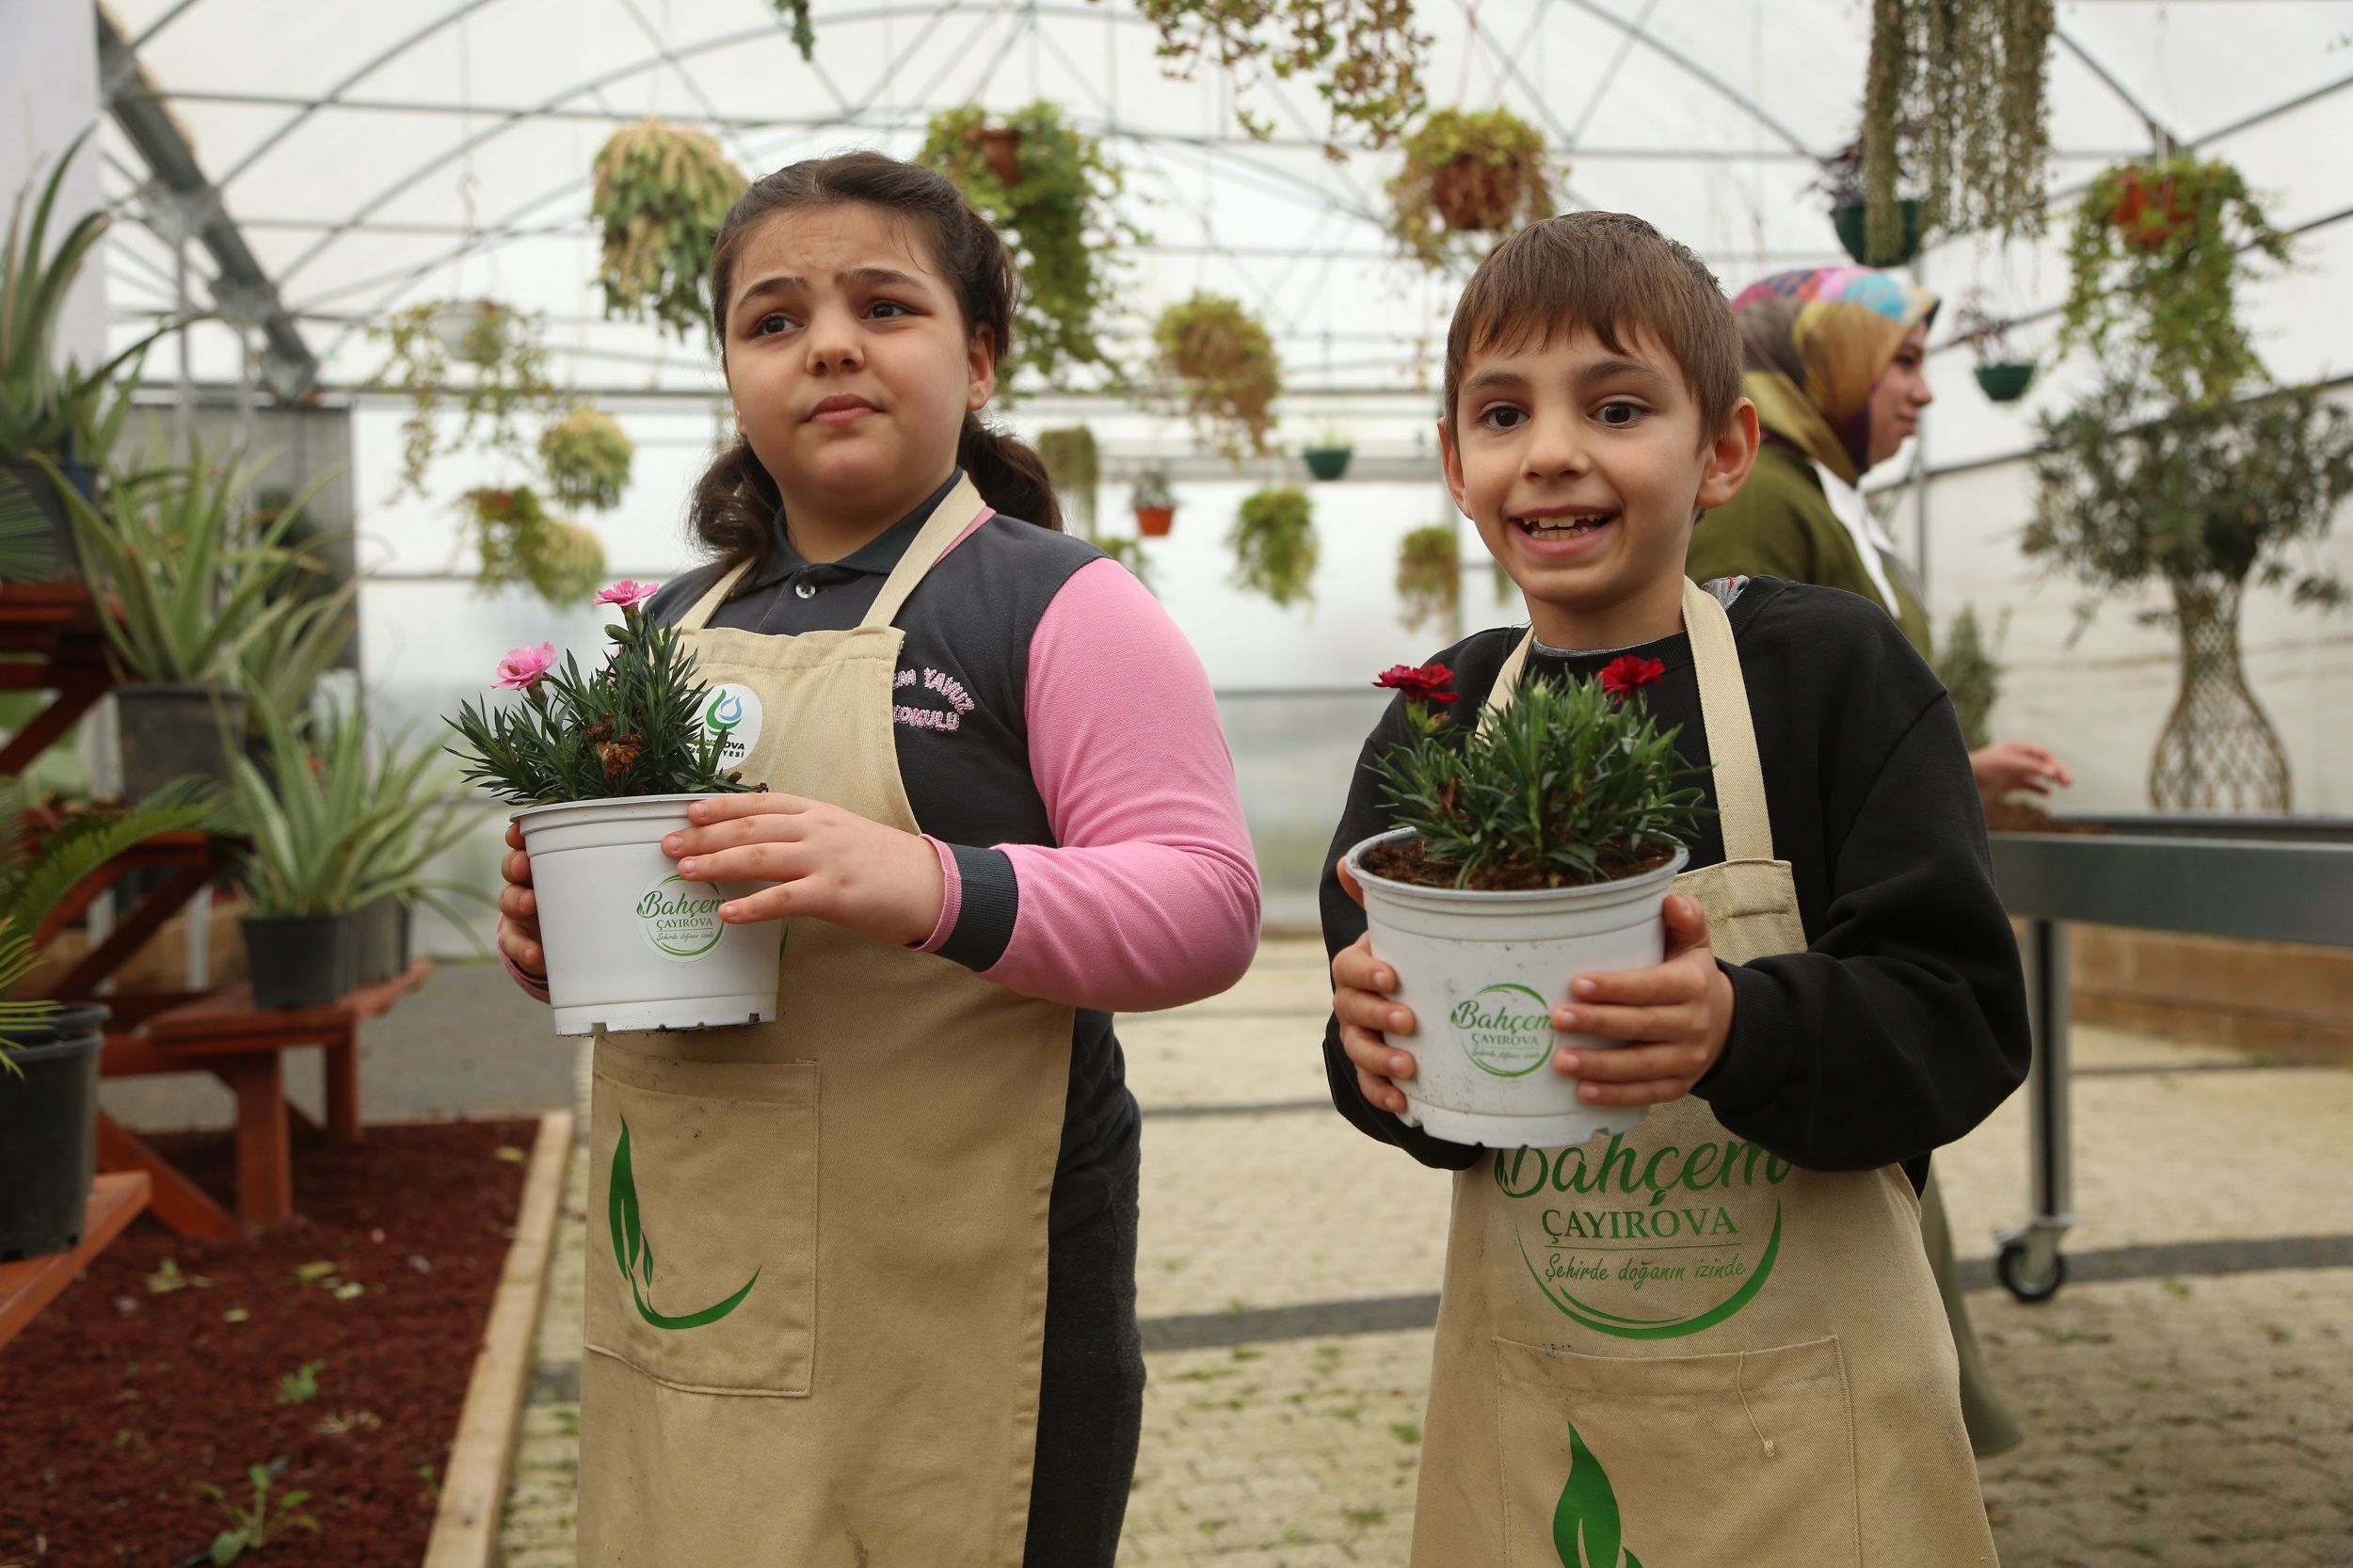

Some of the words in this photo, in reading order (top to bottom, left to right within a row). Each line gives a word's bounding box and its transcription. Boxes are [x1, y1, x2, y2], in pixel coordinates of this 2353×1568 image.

[924, 667, 975, 715] YAVUZ
[656, 918, 713, 930] ÇAYIROVA
[1471, 1032, 1539, 1046] ÇAYIROVA
[1542, 1206, 1739, 1244] ÇAYIROVA
[1545, 1253, 1609, 1283] Şehirde
[1618, 1257, 1686, 1290] doğanın
[1695, 1252, 1746, 1278] izinde
